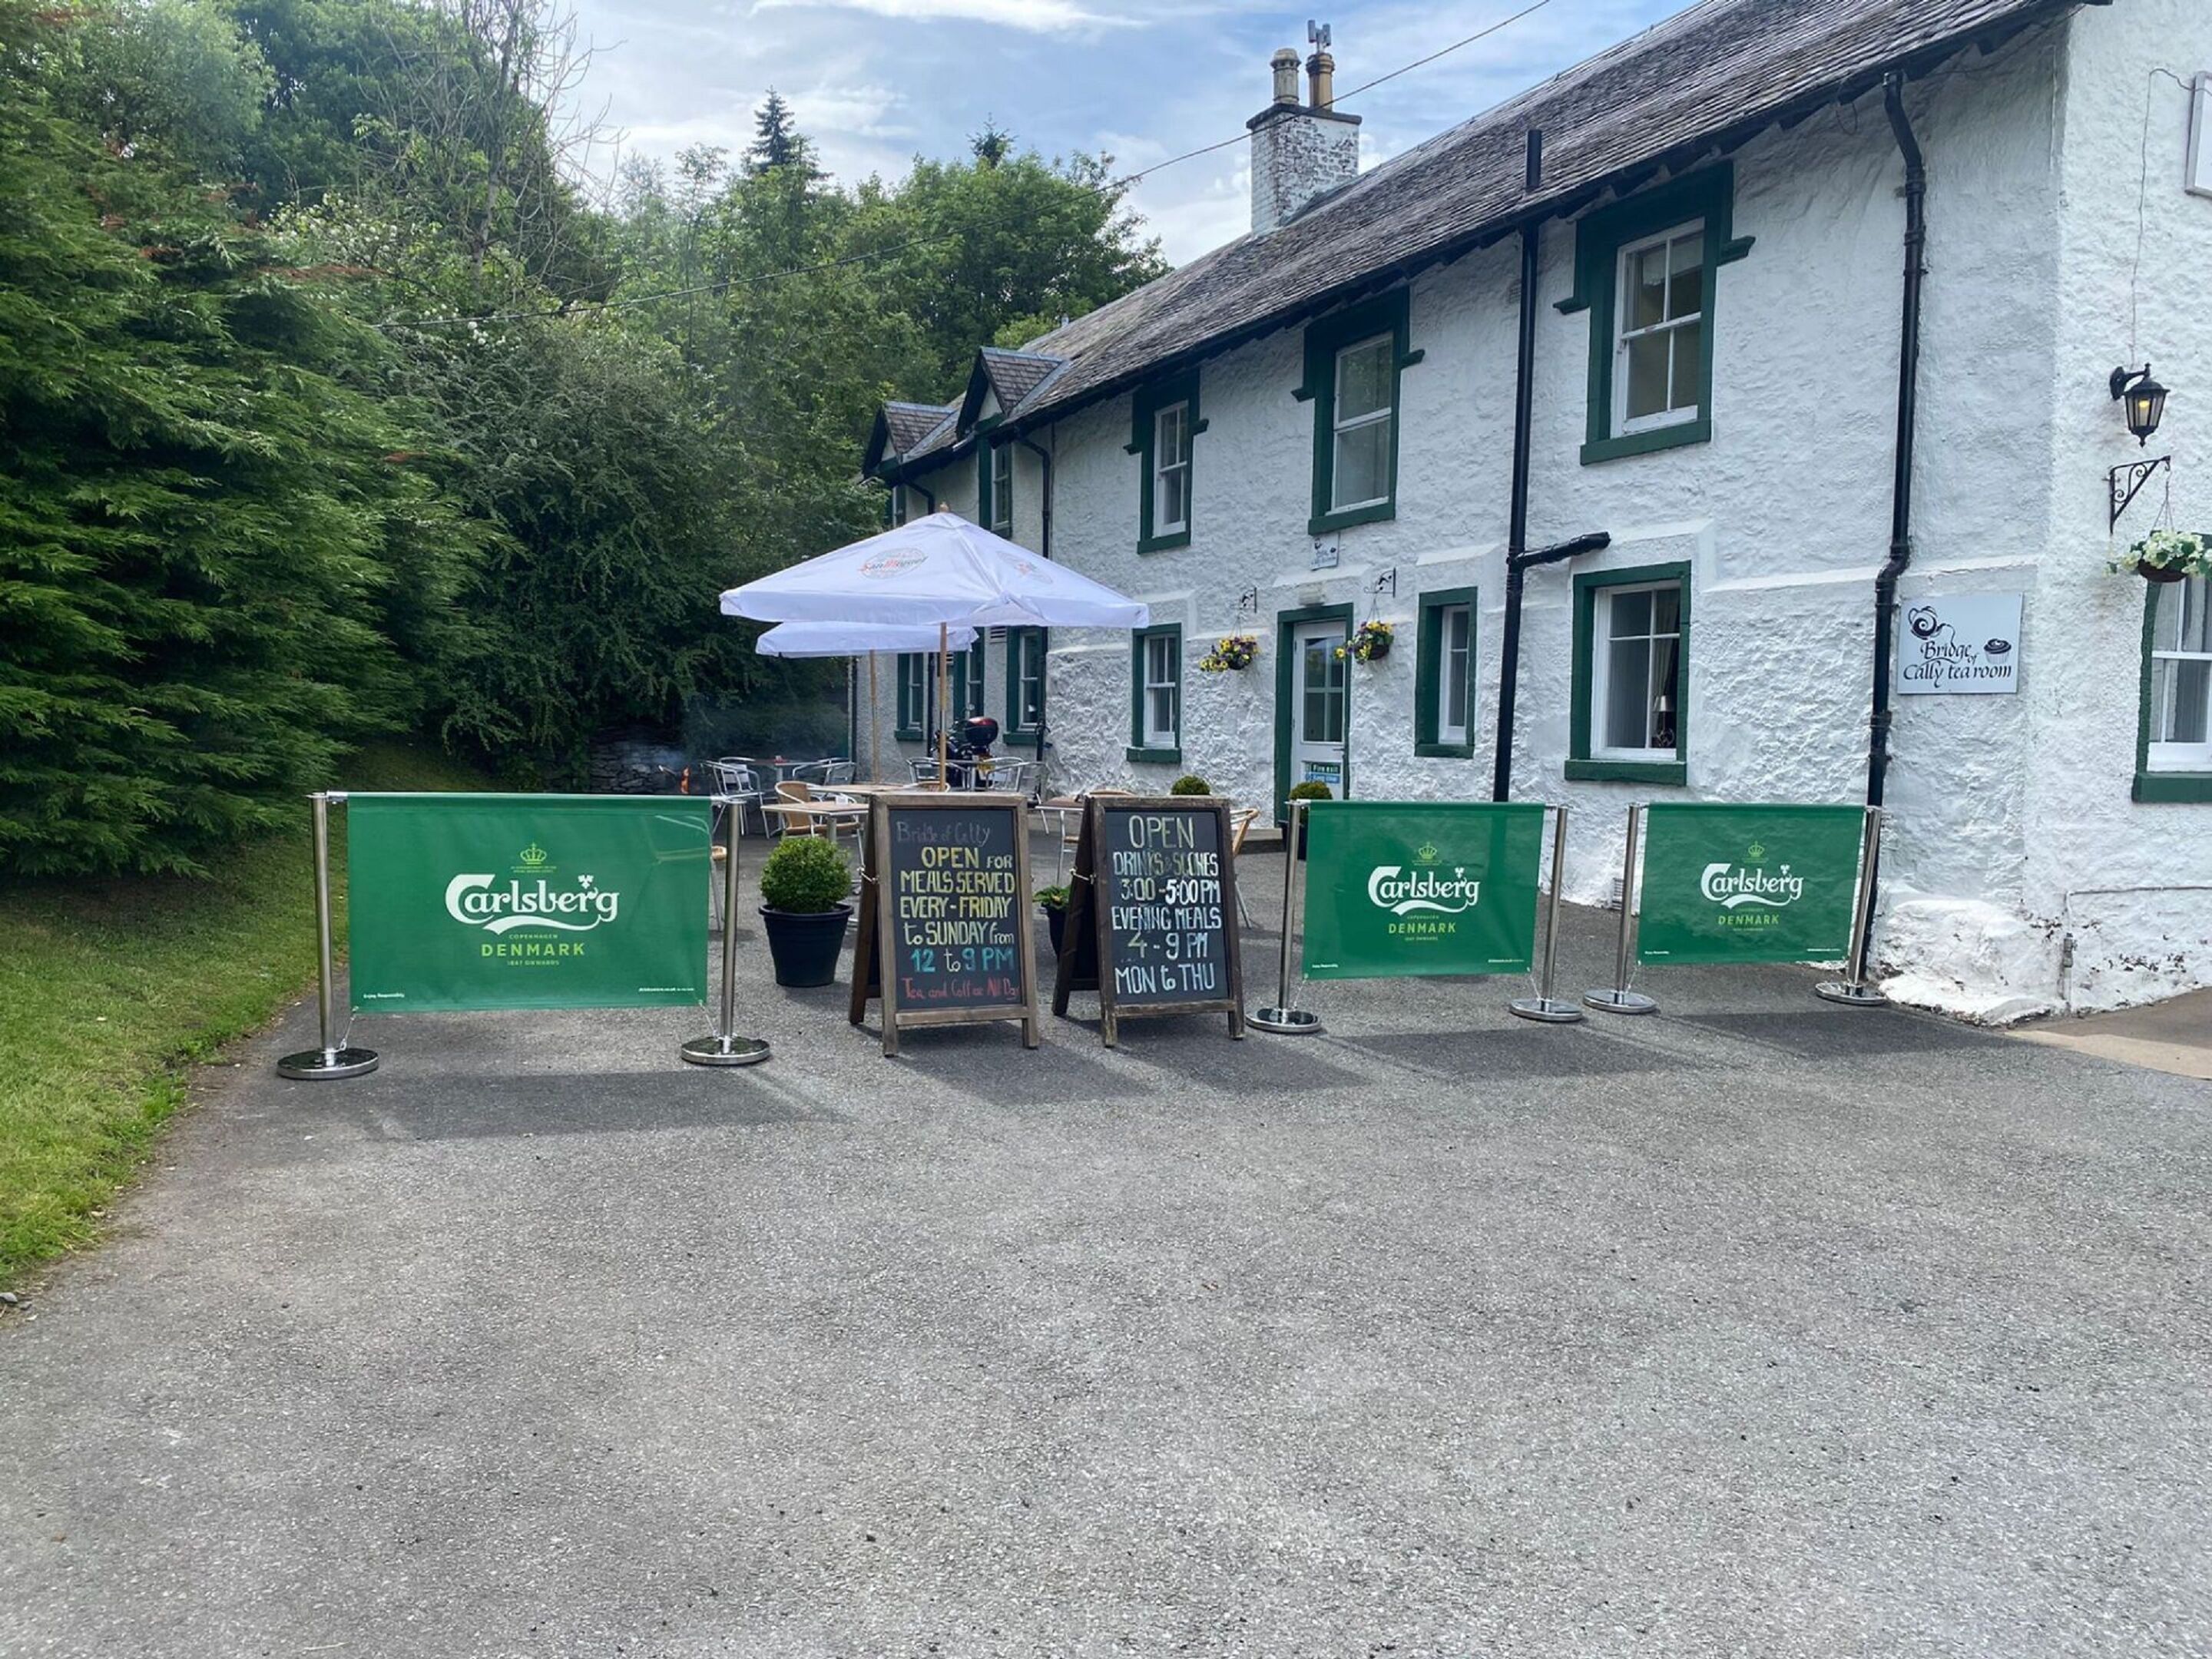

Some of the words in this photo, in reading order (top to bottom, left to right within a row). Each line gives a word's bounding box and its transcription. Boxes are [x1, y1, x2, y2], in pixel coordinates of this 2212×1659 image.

[1920, 641, 1972, 662] Bridge
[1967, 653, 1979, 664] of
[1903, 661, 1943, 688] Cally
[1128, 815, 1194, 849] OPEN
[922, 846, 979, 869] OPEN
[986, 854, 1013, 869] FOR
[1114, 851, 1164, 876] DRINKS
[900, 870, 953, 893] MEALS
[955, 871, 1015, 894] SERVED
[1121, 877, 1156, 901] 3:00
[1368, 866, 1481, 912] Carlsberg
[1700, 863, 1804, 906] Carlsberg
[445, 873, 621, 929] Carlsberg
[900, 896, 949, 919] EVERY
[959, 896, 1012, 919] FRIDAY
[1111, 906, 1171, 930] EVENING
[1174, 906, 1222, 930] MEALS
[1388, 922, 1456, 935] DENMARK
[1717, 914, 1780, 926] DENMARK
[902, 922, 923, 945] to
[925, 921, 988, 945] SUNDAY
[988, 922, 1015, 945] from
[481, 942, 586, 957] DENMARK
[1128, 931, 1147, 959] 4
[1165, 932, 1180, 960] 9
[1187, 932, 1208, 959] PM
[911, 948, 935, 972] 12
[943, 948, 960, 972] to
[962, 947, 976, 972] 9
[982, 947, 1015, 972] PM
[901, 977, 924, 999] Tea
[928, 980, 948, 998] and
[987, 977, 1001, 997] All
[1114, 965, 1157, 995] MON
[1161, 965, 1176, 991] to
[1178, 963, 1215, 992] THU
